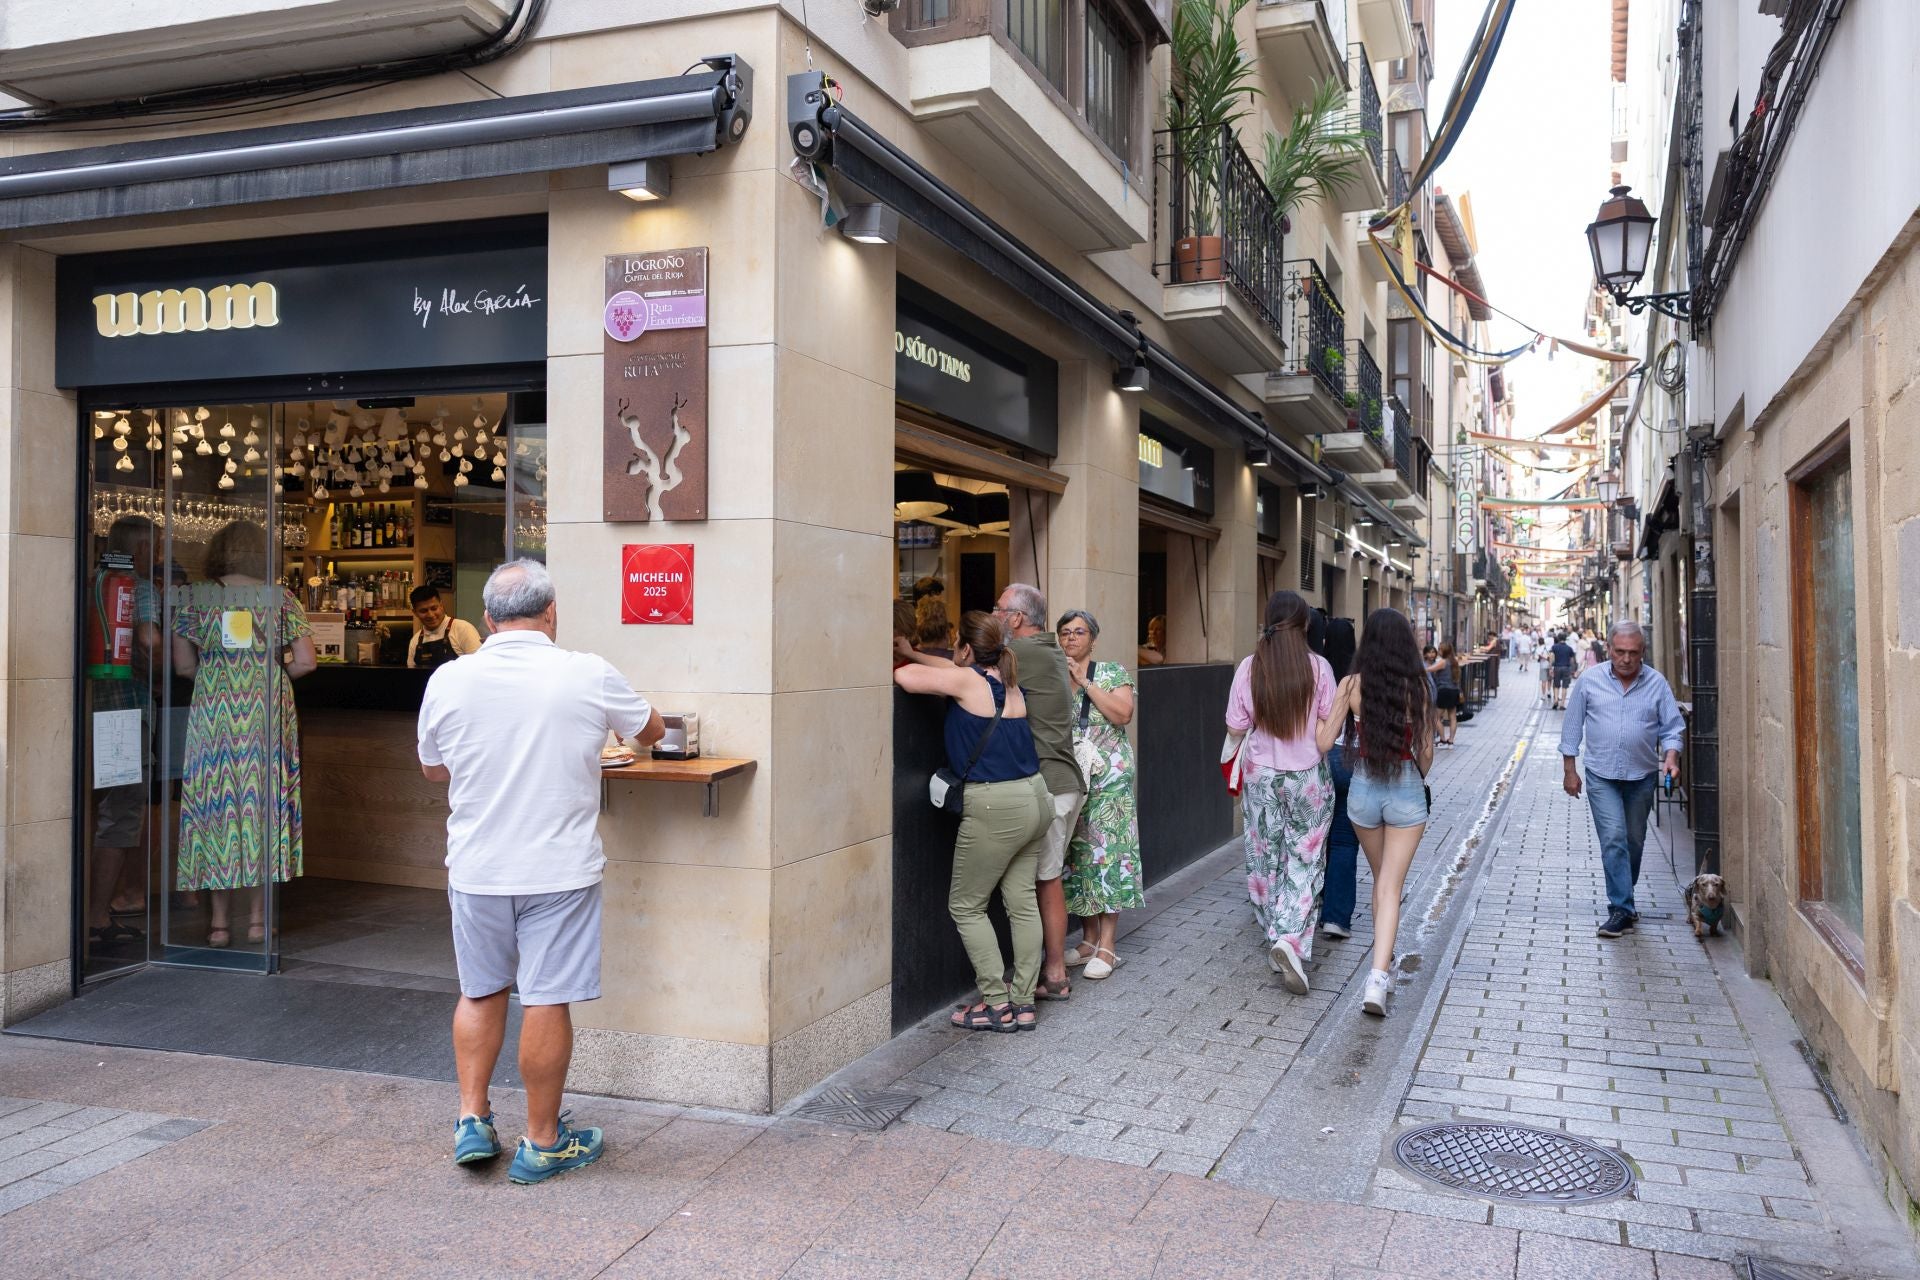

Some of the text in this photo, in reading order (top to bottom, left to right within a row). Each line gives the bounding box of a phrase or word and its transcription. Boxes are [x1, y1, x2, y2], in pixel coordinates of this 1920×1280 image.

[624, 255, 685, 275] LOGROÑO
[624, 273, 650, 283] CAPITAL
[440, 287, 472, 316] Alex
[92, 281, 280, 338] umm
[650, 303, 673, 316] Ruta
[650, 313, 704, 326] Enoturística
[905, 335, 938, 368] SÓLO
[938, 351, 971, 383] TAPAS
[629, 572, 683, 583] MICHELIN
[643, 586, 667, 597] 2025
